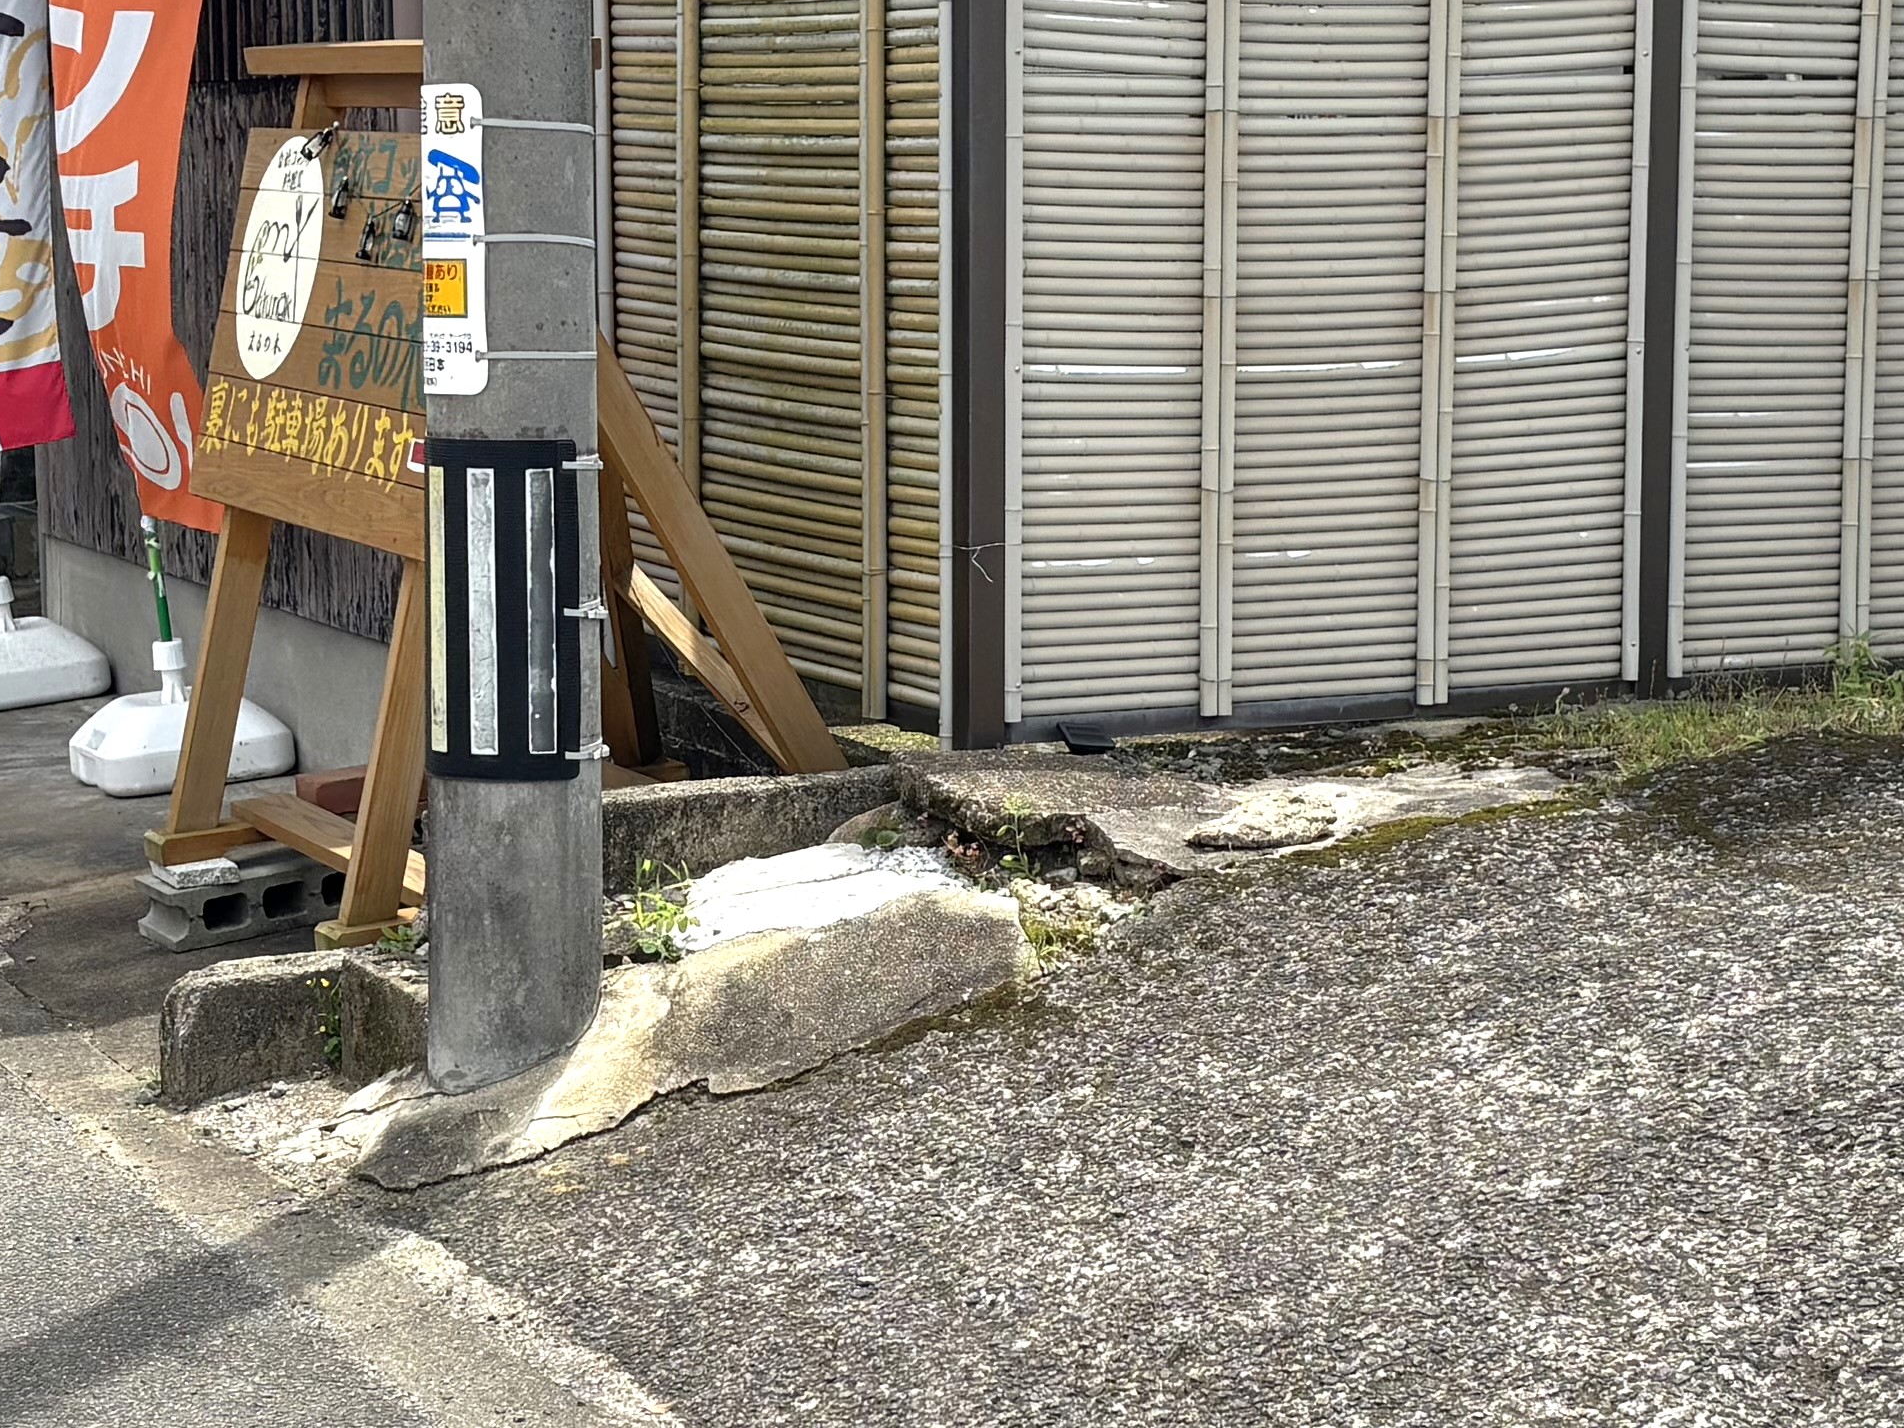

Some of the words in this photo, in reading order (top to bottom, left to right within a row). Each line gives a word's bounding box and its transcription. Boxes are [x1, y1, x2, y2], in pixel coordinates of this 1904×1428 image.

[421, 92, 465, 135] 意
[199, 376, 414, 494] 裏にも駐車場あります
